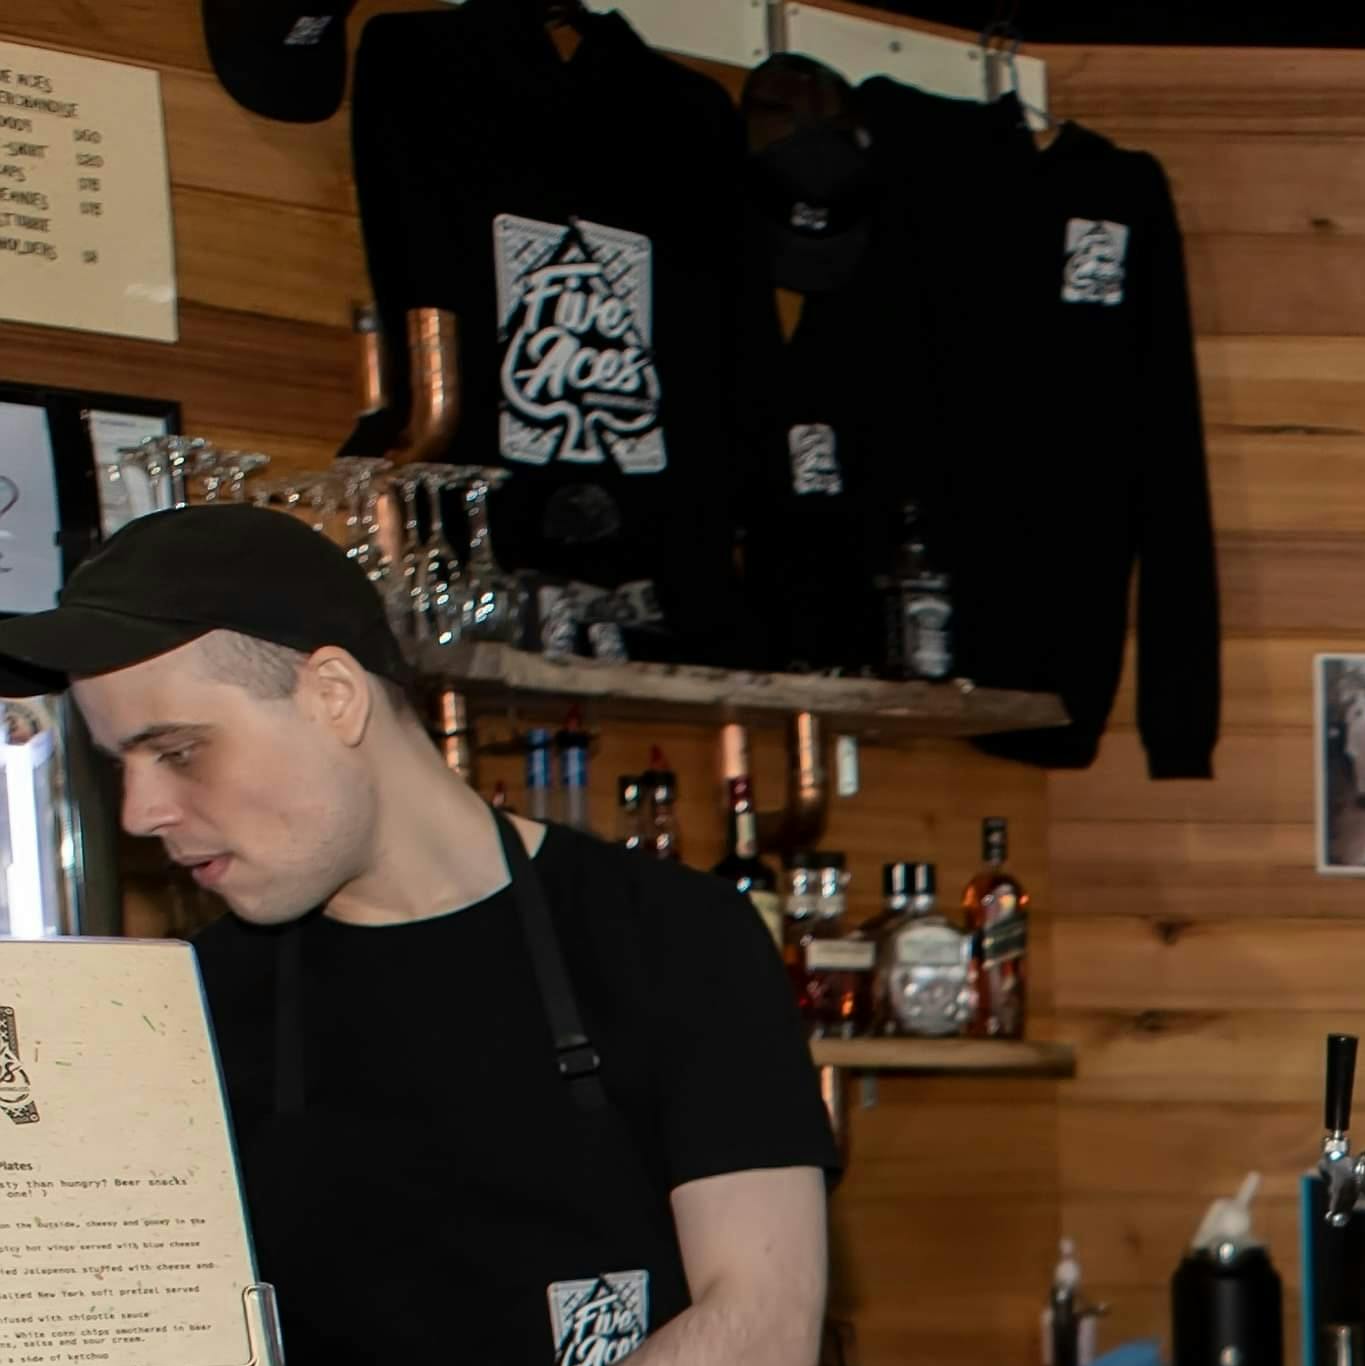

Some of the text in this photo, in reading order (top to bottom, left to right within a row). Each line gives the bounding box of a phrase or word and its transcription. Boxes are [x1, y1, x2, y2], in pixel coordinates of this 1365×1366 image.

[514, 326, 650, 398] Aces
[26, 1180, 54, 1188] than
[60, 1179, 107, 1189] hungry?
[148, 1177, 187, 1187] snacks
